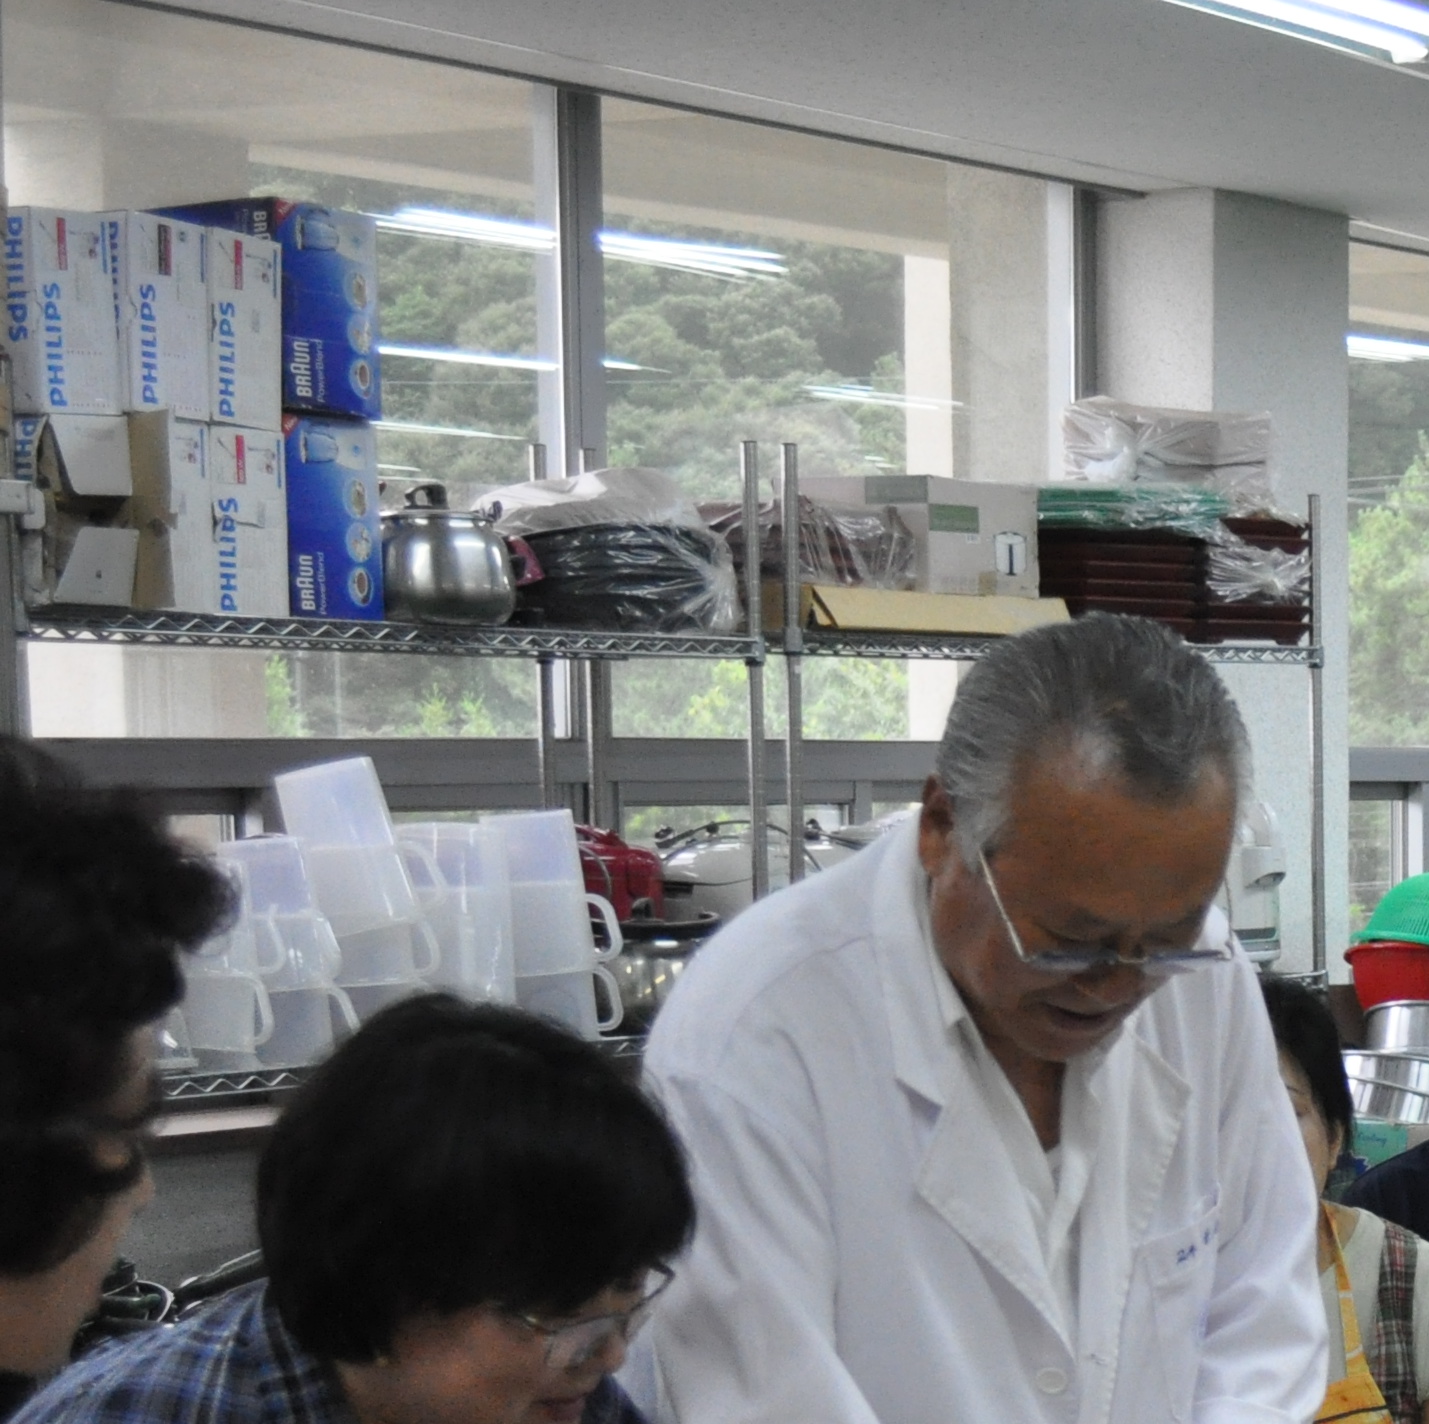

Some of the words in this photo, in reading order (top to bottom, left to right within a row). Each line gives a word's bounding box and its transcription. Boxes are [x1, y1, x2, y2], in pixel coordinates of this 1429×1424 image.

[5, 216, 28, 343] PHILIPS
[44, 282, 67, 407] PHILIPS
[140, 284, 158, 405] PHILIPS
[219, 302, 235, 418] PHILIPS
[218, 498, 238, 611] PHILIPS
